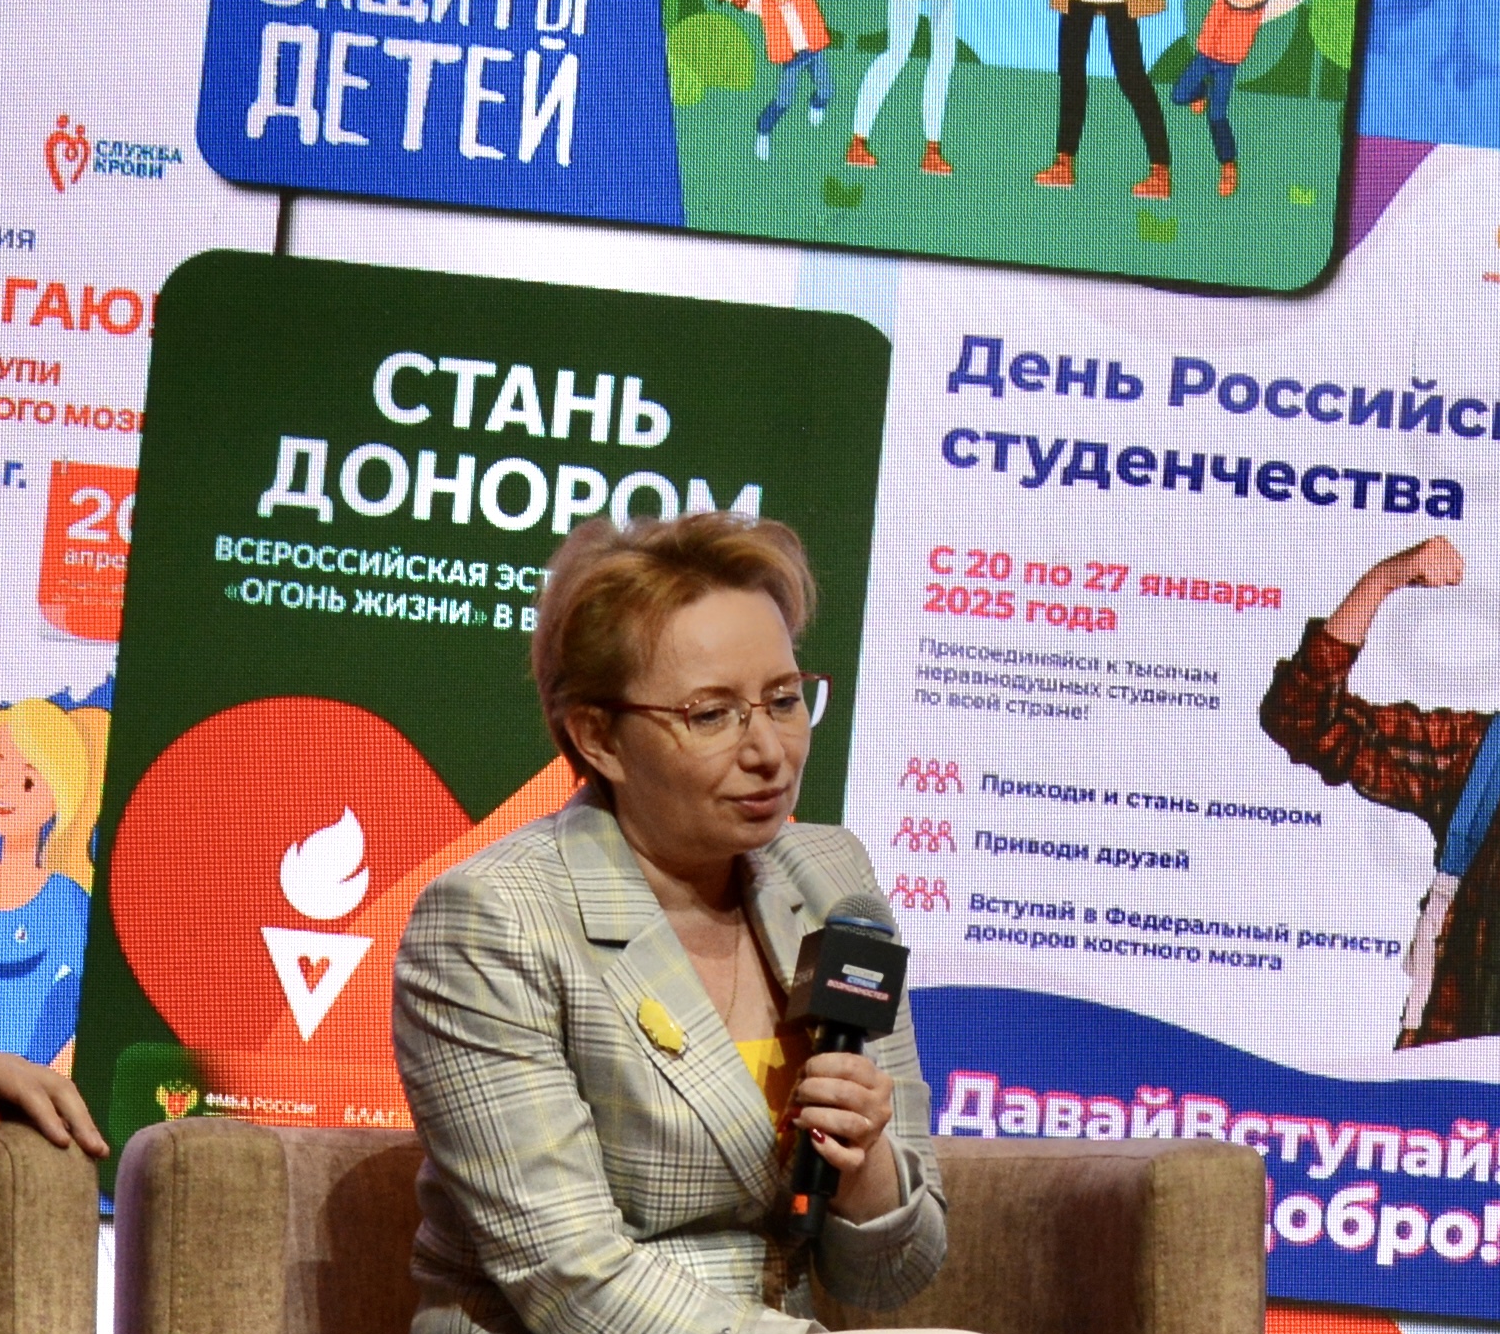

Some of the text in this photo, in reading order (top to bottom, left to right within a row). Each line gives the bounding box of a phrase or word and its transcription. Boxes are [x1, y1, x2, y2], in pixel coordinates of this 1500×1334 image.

[246, 21, 579, 166] ДЕТЕЙ
[94, 140, 183, 165] СЛУЖБА
[947, 332, 1143, 407] День
[372, 350, 672, 450] СТАНЬ
[3, 459, 28, 489] г.
[940, 424, 1466, 521] студенчества
[214, 535, 488, 588] ВСЕРОССИЙСКАЯ
[928, 544, 1283, 612] С 20 по 27 января
[493, 603, 514, 631] В
[923, 581, 1118, 633] 2025 года
[980, 773, 1323, 827] Приходи и стань донором
[974, 829, 1191, 873] Приводи друзей
[963, 921, 1283, 972] доноров костного мозга
[968, 892, 1402, 959] Вступай в Федеральный регистр
